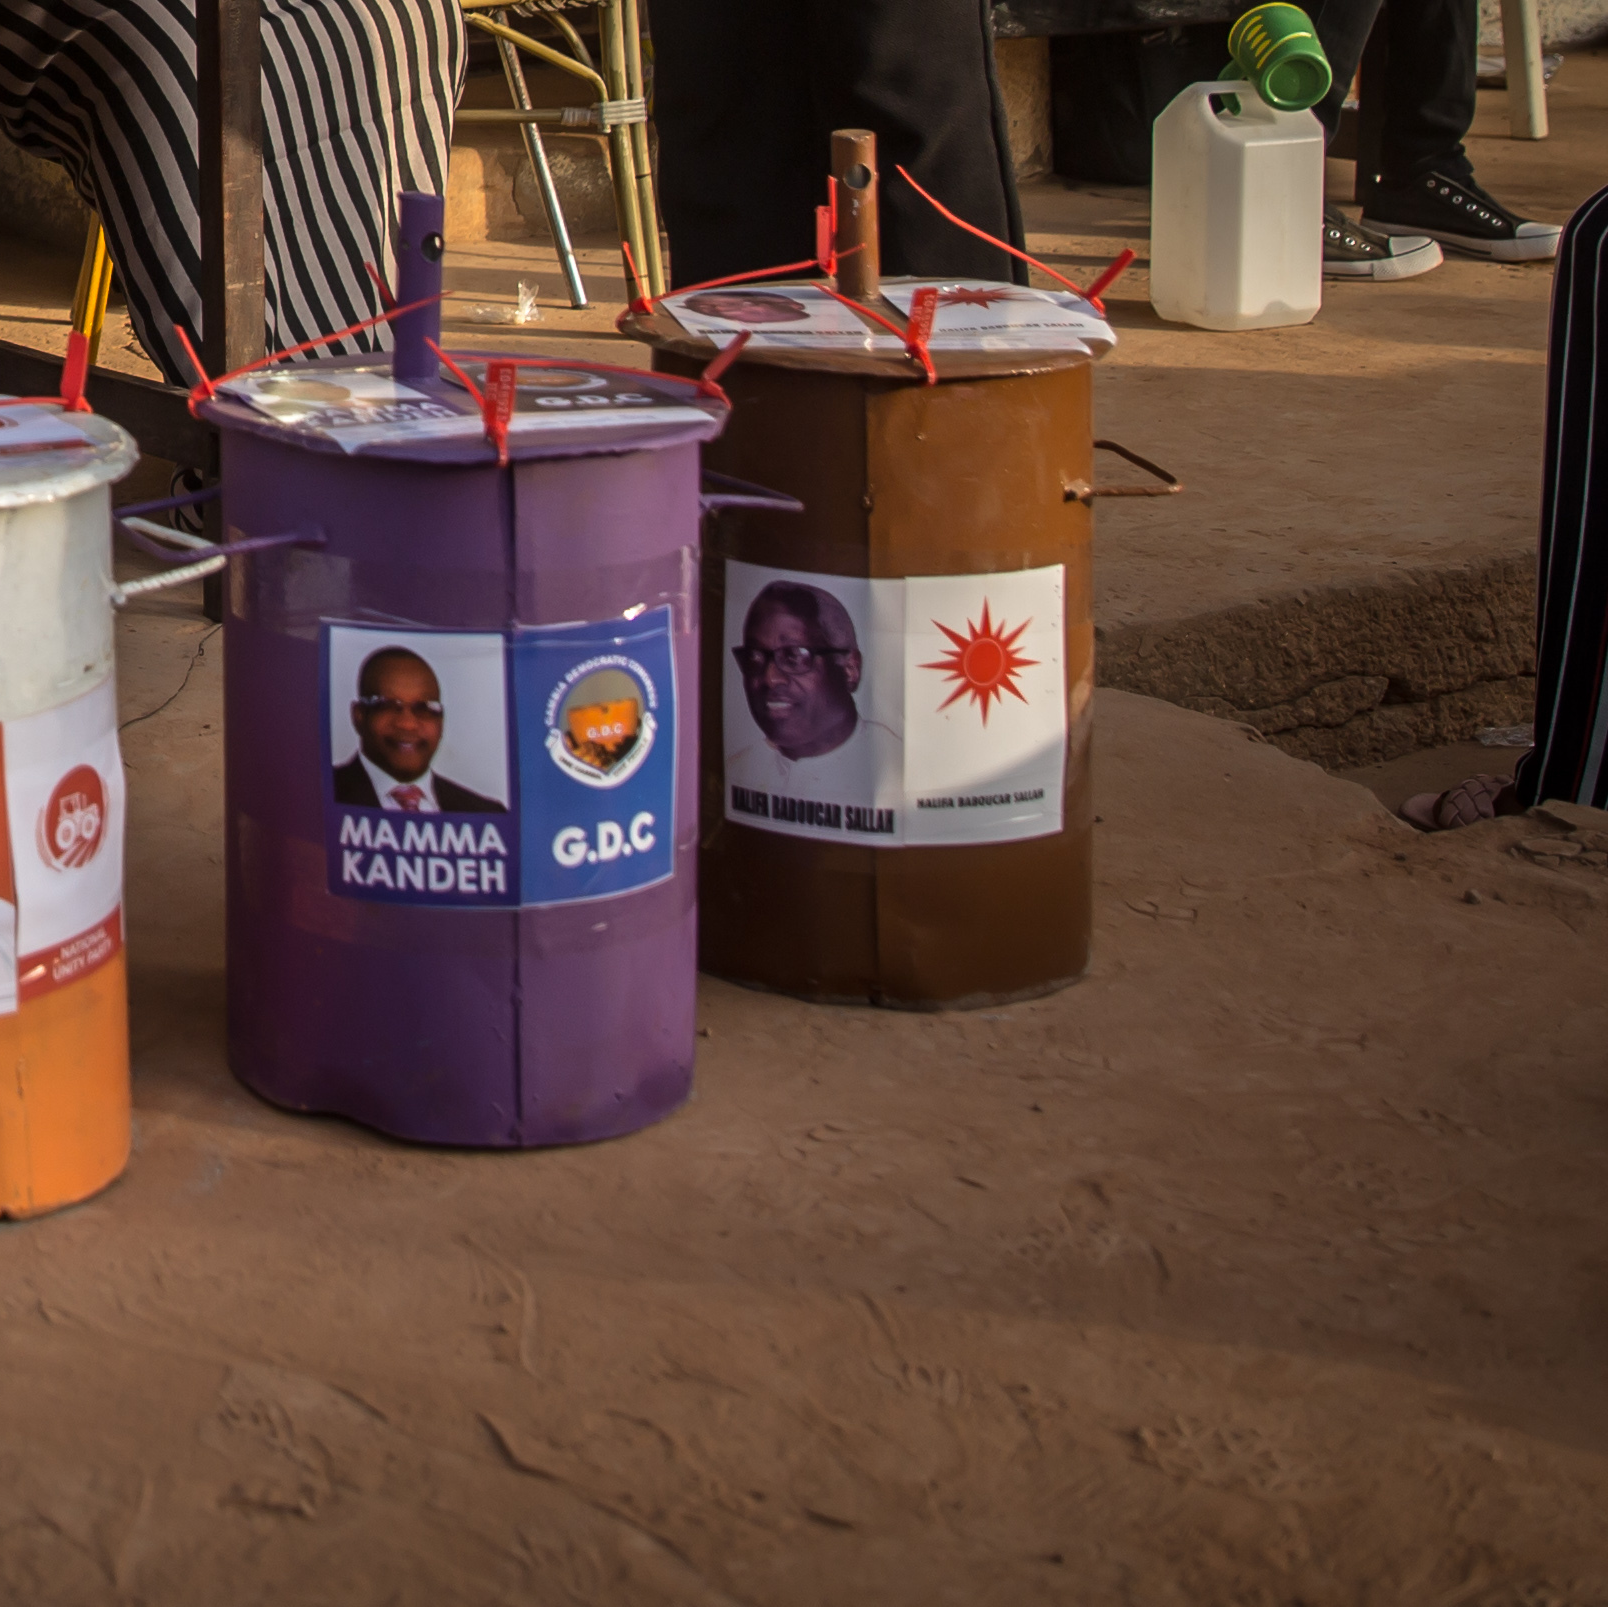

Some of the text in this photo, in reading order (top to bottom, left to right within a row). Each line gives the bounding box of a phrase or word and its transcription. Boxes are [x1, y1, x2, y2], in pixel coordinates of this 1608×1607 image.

[339, 814, 509, 856] MAMMA
[552, 810, 656, 869] G.D.C
[844, 804, 896, 834] SALLAH
[341, 849, 506, 893] KANDEH
